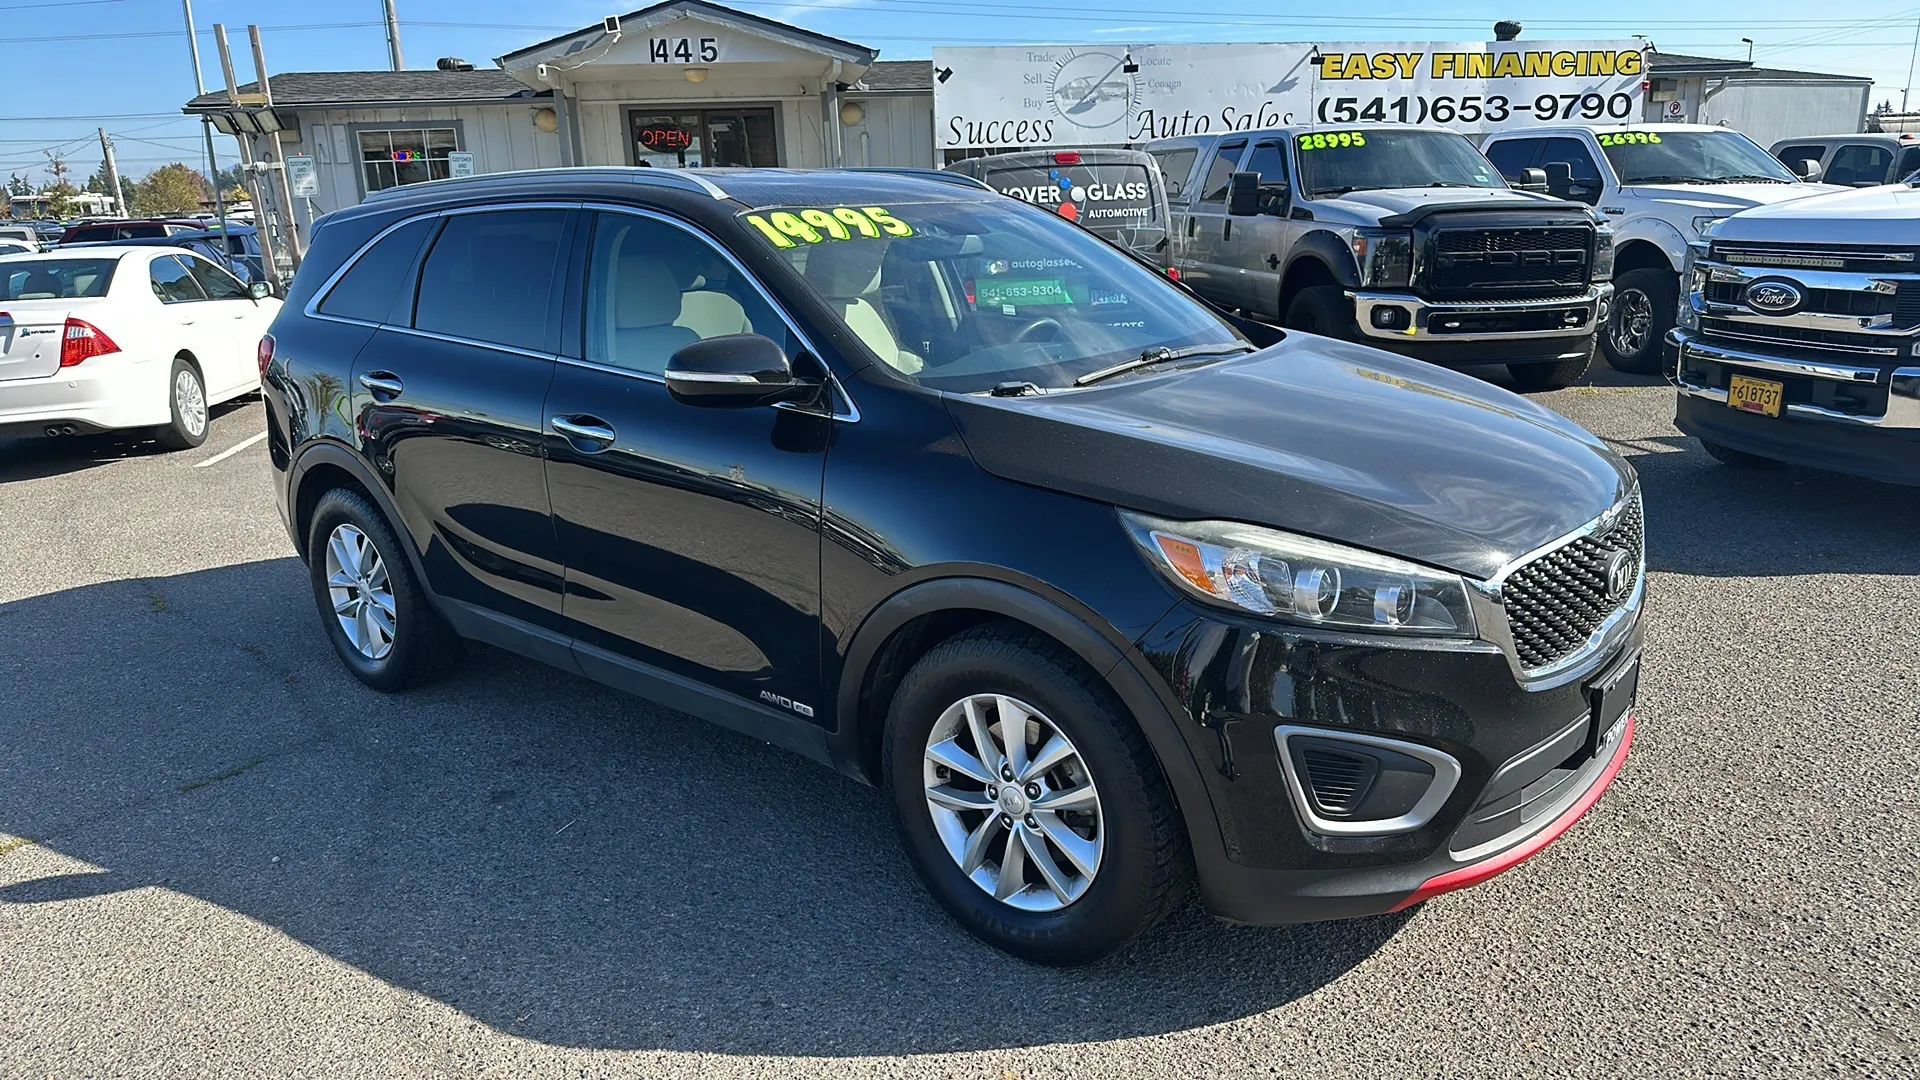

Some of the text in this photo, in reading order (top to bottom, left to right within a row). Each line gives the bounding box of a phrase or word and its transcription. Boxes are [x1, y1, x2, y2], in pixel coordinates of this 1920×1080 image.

[650, 38, 718, 62] 1445
[1026, 52, 1055, 62] Trade
[1140, 56, 1171, 66] Locate
[1320, 50, 1643, 80] EASY FINANCING
[1024, 73, 1042, 84] Sell
[1148, 79, 1181, 89] Consign
[1024, 98, 1043, 110] Buy
[1317, 92, 1633, 124] (541)653-9790
[947, 101, 1293, 145] Success Auto Sales
[642, 130, 690, 147] OPEN
[1300, 132, 1366, 151] 28995
[1599, 132, 1662, 148] 26996
[1087, 183, 1147, 202] GLASS
[1089, 208, 1148, 219] AUTOMOTIVE
[747, 207, 912, 249] 14995
[1756, 287, 1787, 305] Ford
[760, 690, 792, 709] AWD
